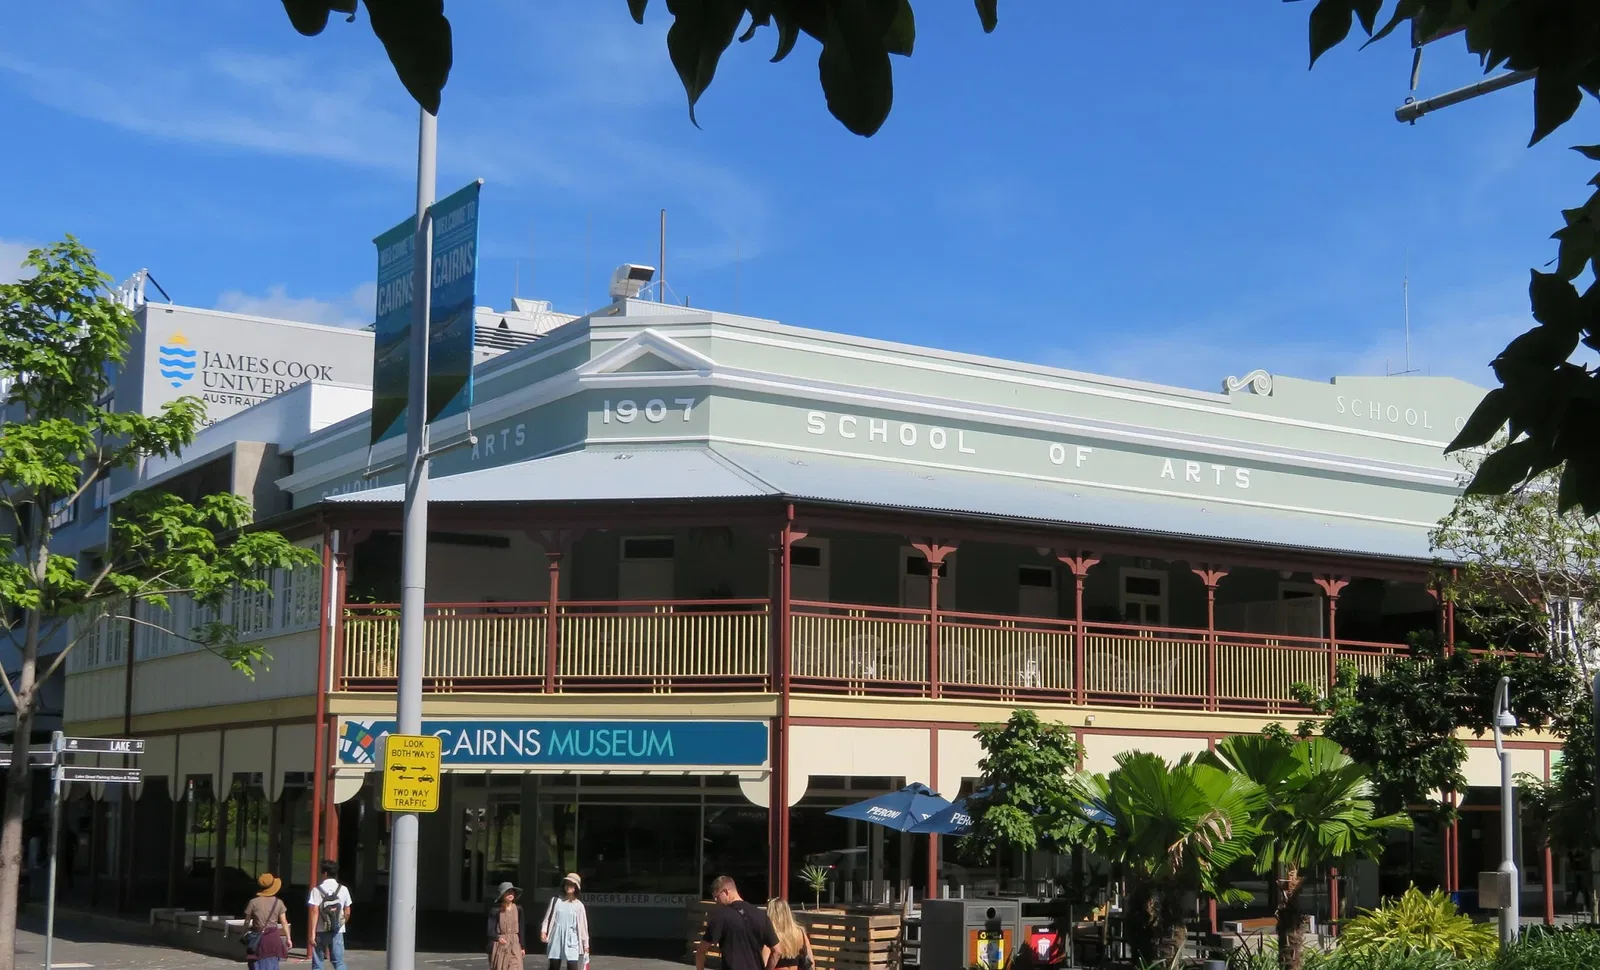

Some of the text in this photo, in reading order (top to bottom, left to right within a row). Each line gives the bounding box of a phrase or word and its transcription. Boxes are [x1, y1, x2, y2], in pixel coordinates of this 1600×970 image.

[436, 205, 466, 236] WELCOME
[433, 240, 474, 289] CAIRNS
[377, 271, 415, 317] CAIRNS
[202, 350, 334, 381] JAMES COOK
[603, 398, 695, 424] 1907
[1336, 395, 1433, 429] SCHOOL
[806, 411, 1251, 490] SCHOOL OF ARTS
[110, 741, 131, 752] LAKE
[404, 740, 425, 748] LOOK
[414, 751, 436, 759] WAYS
[432, 729, 675, 757] CAIRNS MUSEUM
[393, 789, 410, 797] TWO
[394, 799, 428, 807] TRAFFIC
[866, 806, 902, 818] PERONI
[625, 895, 649, 904] BEER
